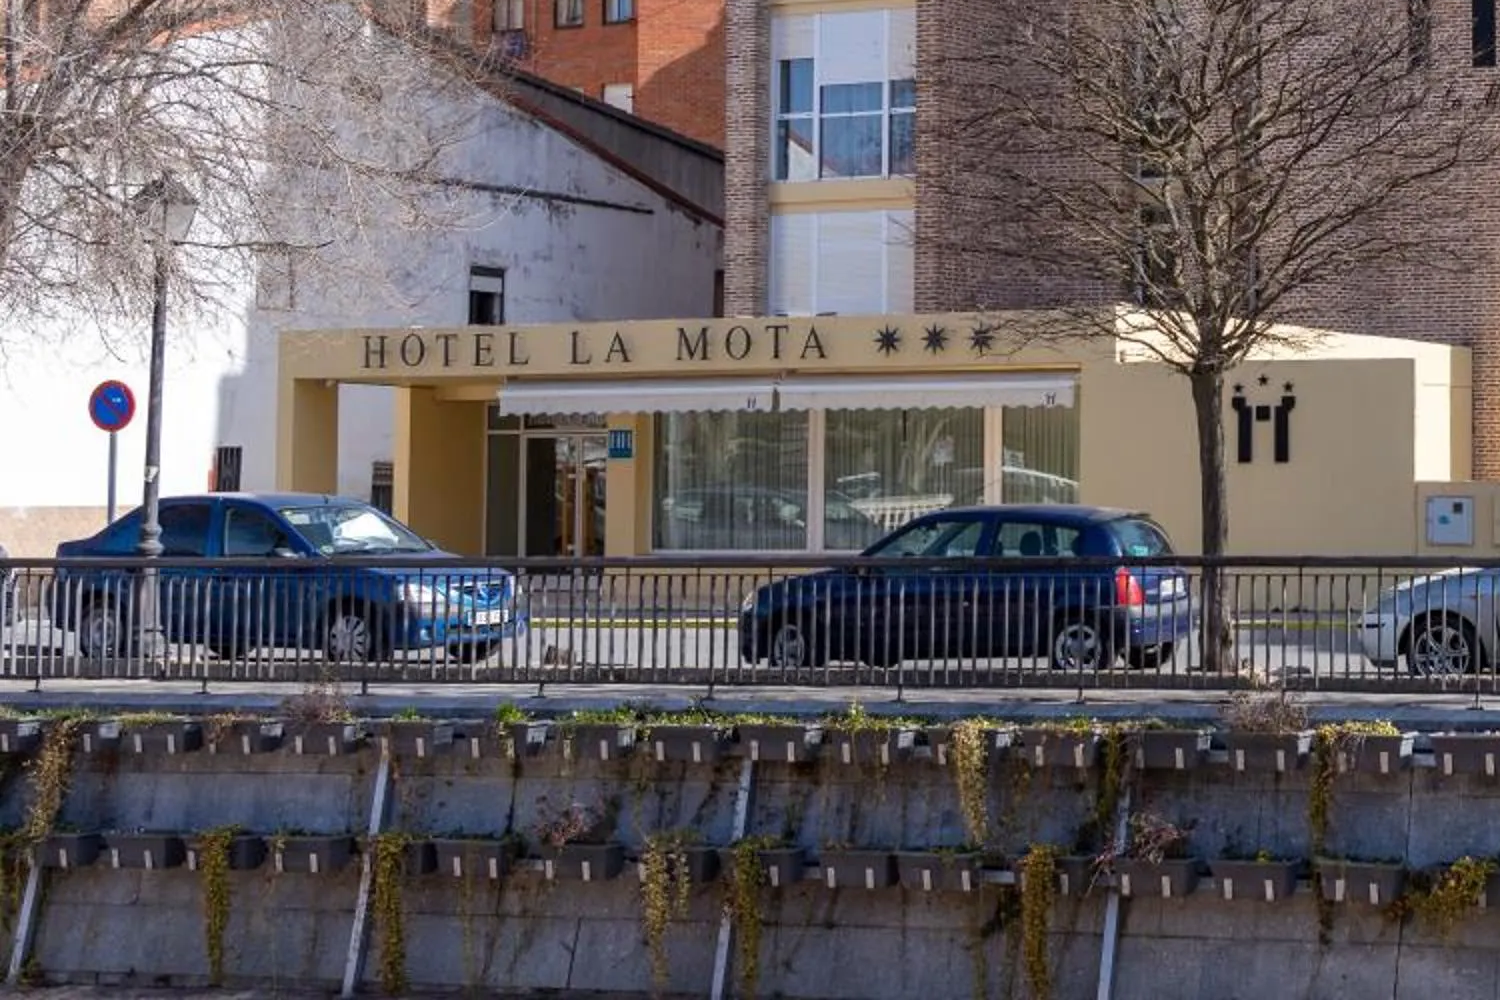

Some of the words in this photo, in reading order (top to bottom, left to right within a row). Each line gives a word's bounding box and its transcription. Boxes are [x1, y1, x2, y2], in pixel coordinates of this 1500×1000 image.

[361, 331, 531, 369] HOTEL
[569, 330, 632, 365] LA
[676, 324, 828, 361] MOTA
